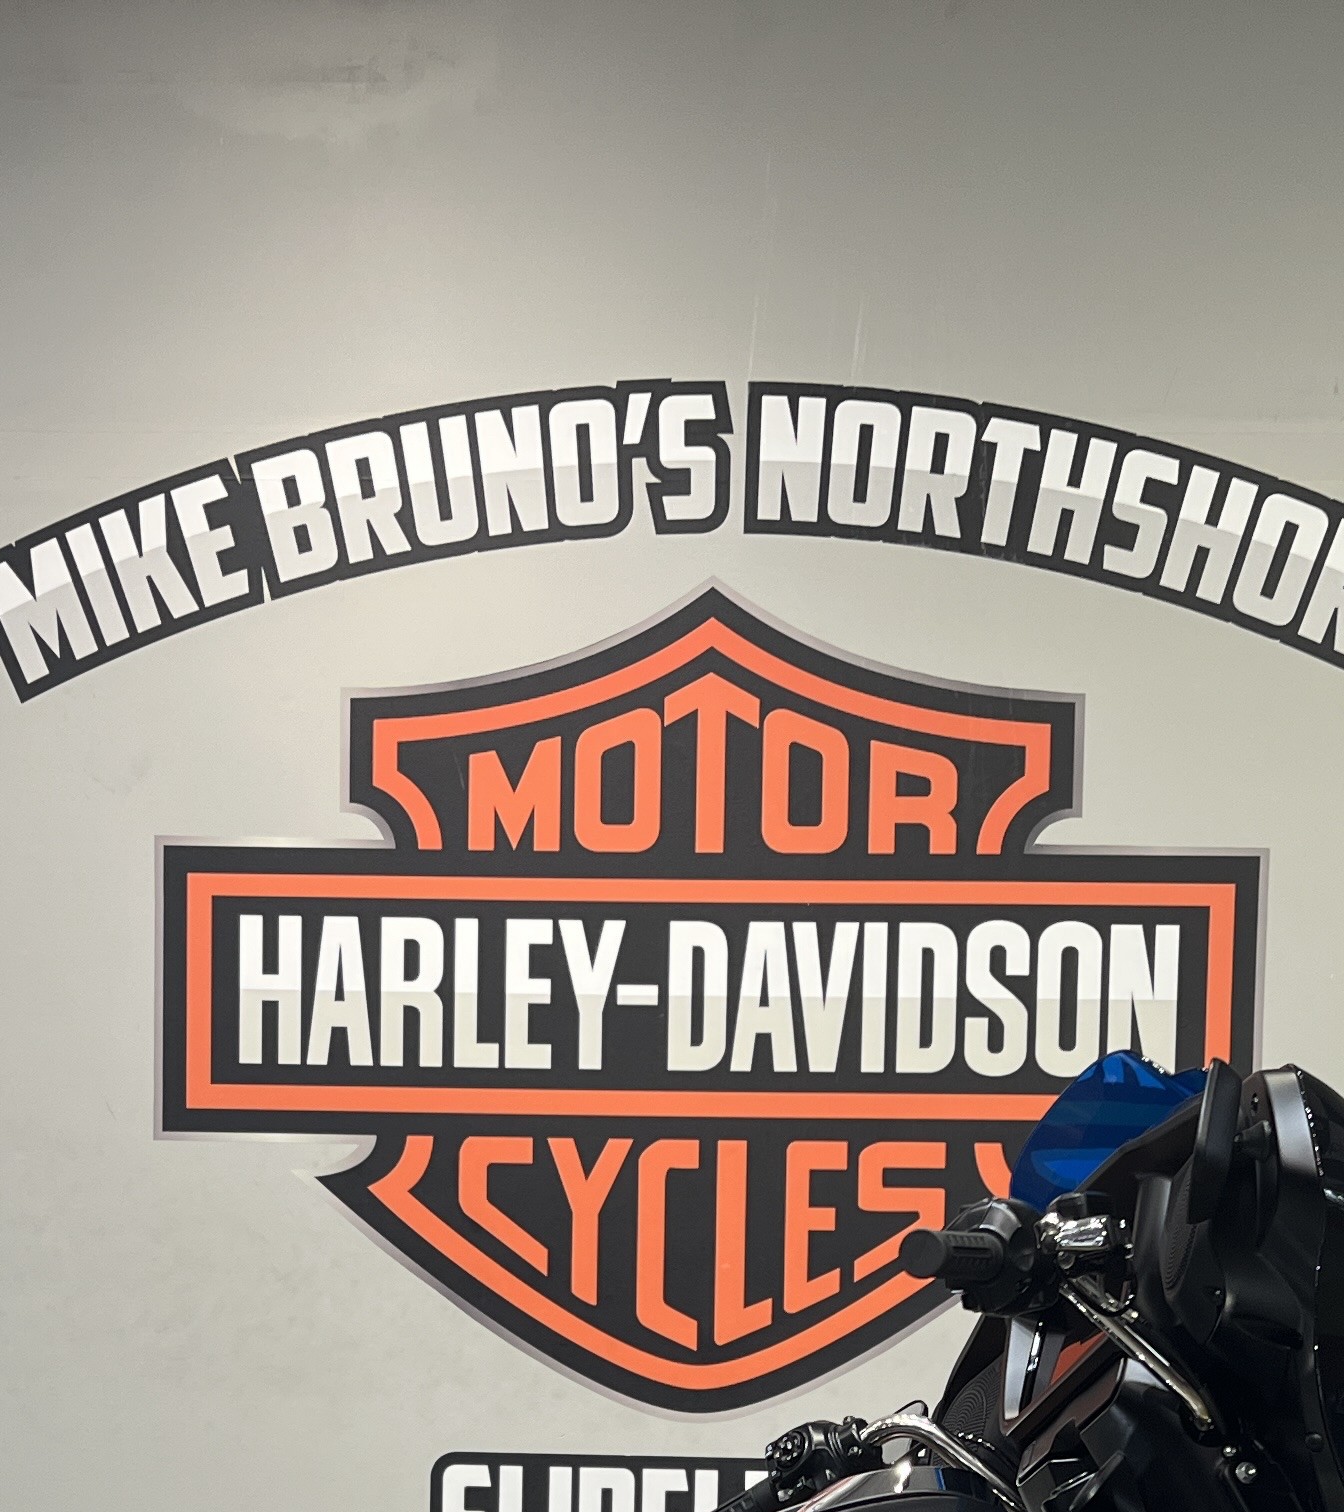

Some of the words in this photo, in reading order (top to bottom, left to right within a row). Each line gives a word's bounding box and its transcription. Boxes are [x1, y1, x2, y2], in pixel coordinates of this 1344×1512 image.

[251, 393, 717, 582] BRUNO'S
[469, 674, 958, 855] MOTOR
[239, 914, 1180, 1077] HARLEY-DAVIDSON
[460, 1137, 946, 1350] CYCLES
